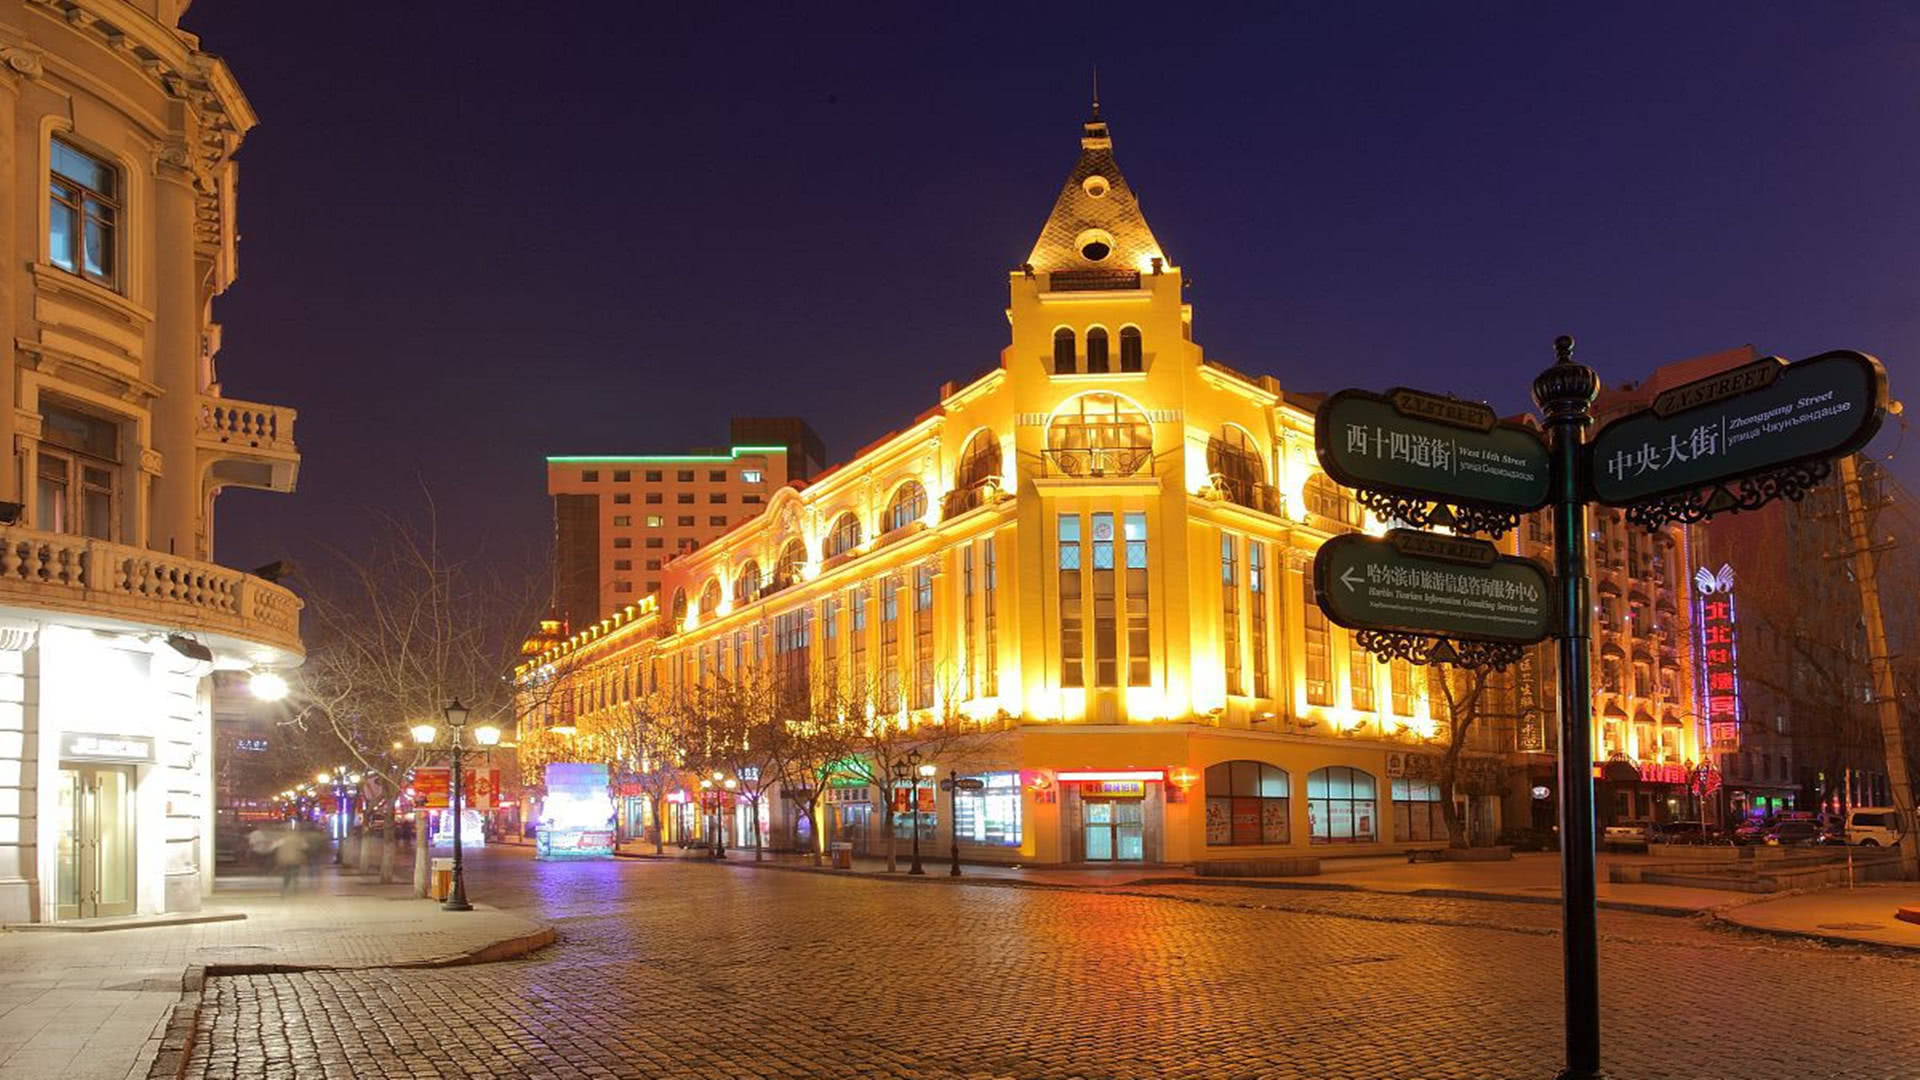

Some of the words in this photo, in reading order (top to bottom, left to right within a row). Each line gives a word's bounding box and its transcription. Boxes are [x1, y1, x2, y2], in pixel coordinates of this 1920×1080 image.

[1728, 404, 1793, 430] Zhongyang
[1796, 391, 1833, 409] Street
[1346, 423, 1451, 472] 西十四道街
[1459, 447, 1480, 458] West
[1501, 455, 1527, 467] Street
[1607, 423, 1720, 481] 中央大街
[1367, 563, 1538, 602] 哈尔滨市旅游信息咨询服务中心
[1368, 586, 1394, 598] Harbin
[1396, 590, 1423, 601] Tourism
[1424, 593, 1461, 605] Information
